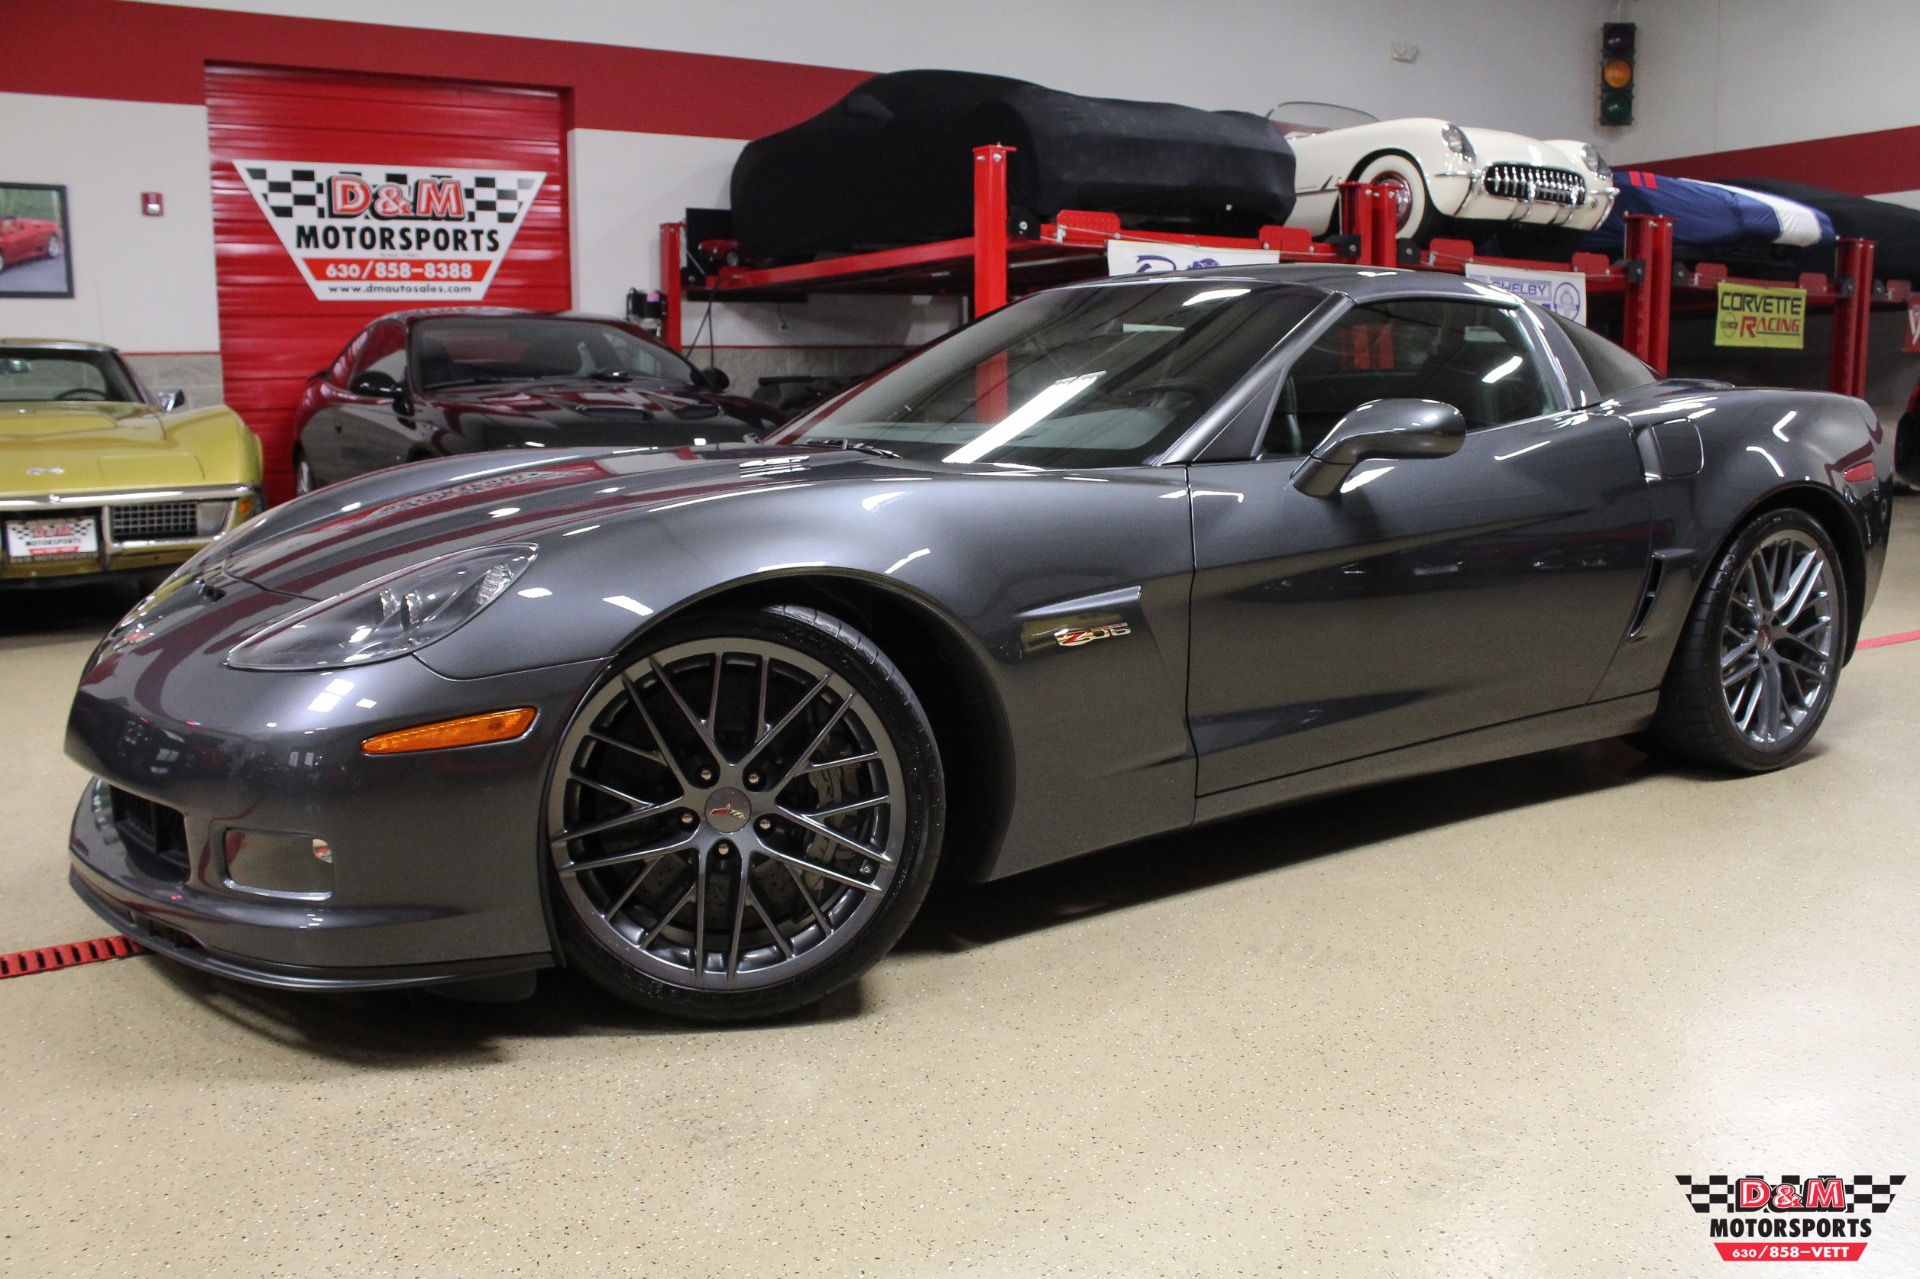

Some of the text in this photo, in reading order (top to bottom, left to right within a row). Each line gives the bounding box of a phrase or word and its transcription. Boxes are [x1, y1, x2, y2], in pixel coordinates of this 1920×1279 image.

[329, 175, 465, 221] D&M
[296, 225, 500, 252] MOTORSPORTS
[325, 260, 473, 280] 630/858-8388
[327, 284, 472, 294] www.dmautosales.com
[1720, 291, 1803, 315] CORVETTE
[1739, 316, 1801, 338] RACING
[1054, 627, 1132, 647] Z06
